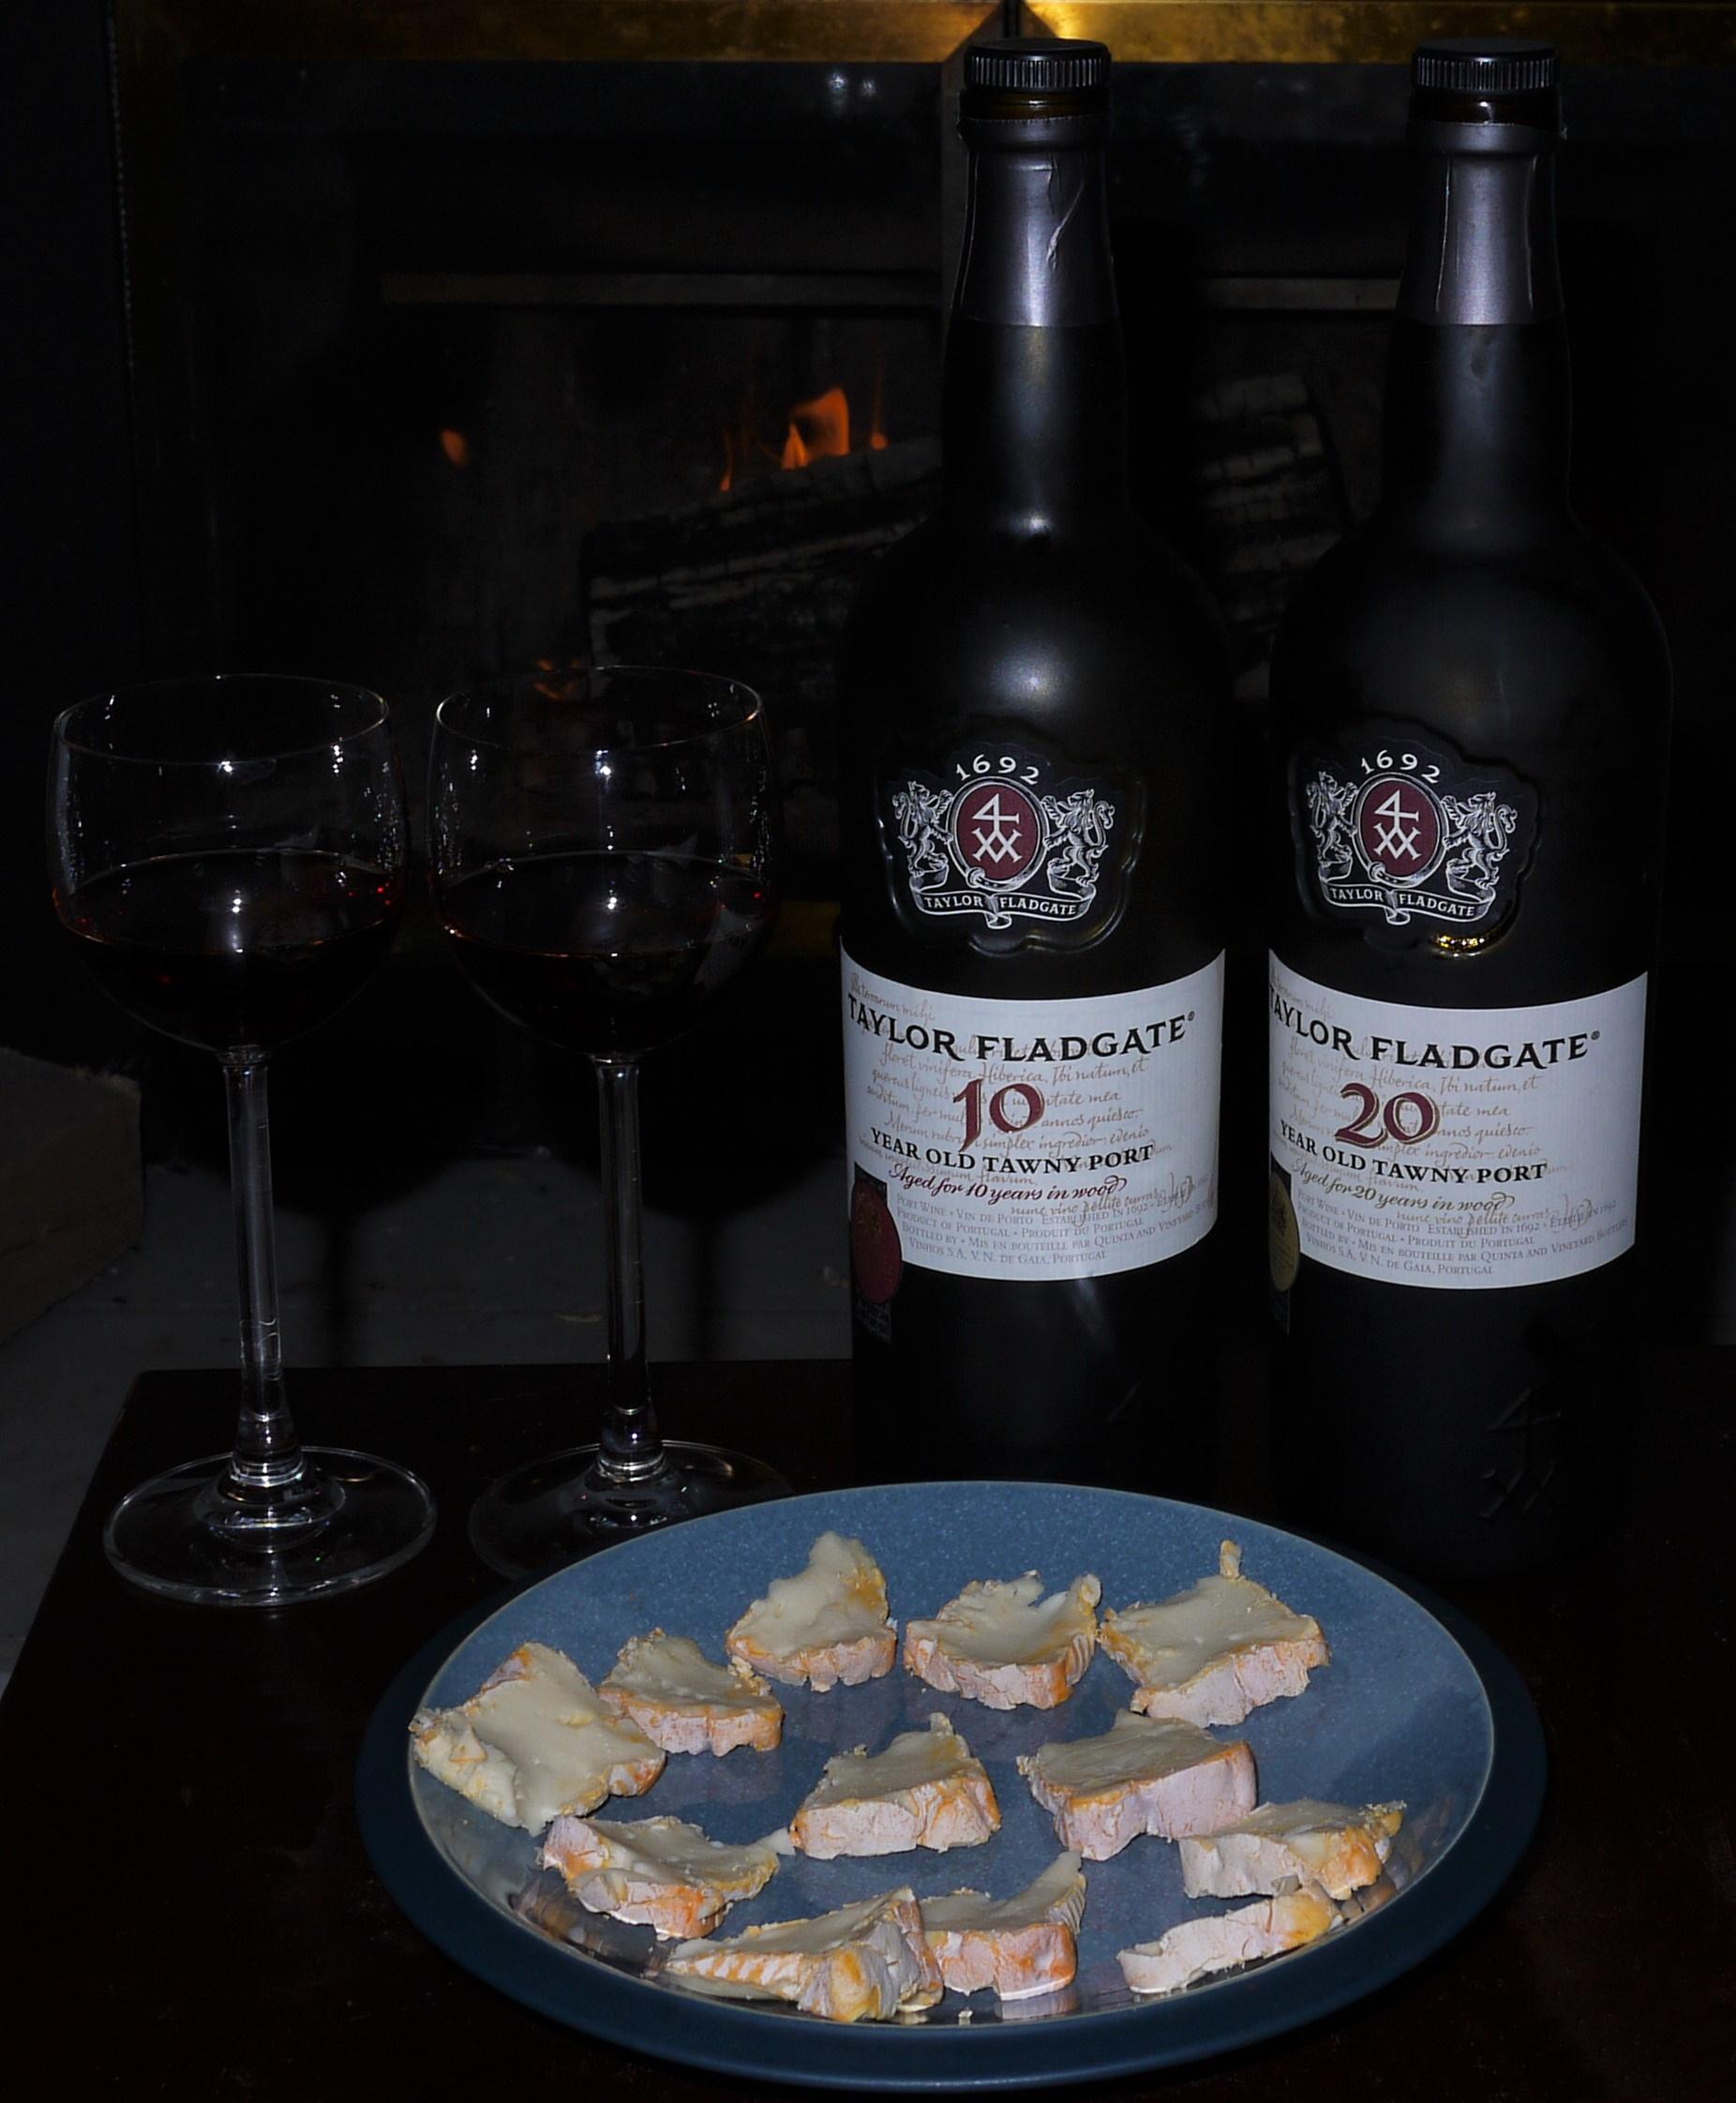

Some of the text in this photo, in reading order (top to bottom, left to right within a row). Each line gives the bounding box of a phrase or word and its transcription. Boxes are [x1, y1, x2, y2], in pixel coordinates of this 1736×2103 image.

[956, 754, 1040, 786] 1692
[1361, 750, 1441, 784] 1692
[923, 895, 1078, 916] TAYLOR FLADGATE
[1329, 887, 1476, 918] TAYLOR FLADGATE
[848, 993, 965, 1061] TAYLOR
[953, 1078, 1046, 1153] 10
[1335, 1083, 1441, 1149] 20
[871, 1127, 921, 1161] YEAR
[926, 1149, 975, 1171] OLD
[982, 1156, 1081, 1175] TAWNY
[1088, 1145, 1154, 1170] PORT
[1280, 1119, 1318, 1155] YEAR
[1323, 1145, 1366, 1171] OLD
[1372, 1159, 1470, 1184] TAWNY
[1477, 1164, 1548, 1184] PORT
[890, 1164, 1128, 1206] Aged for 10 years in wood
[1293, 1161, 1329, 1185] Aged
[1325, 1177, 1353, 1194] for
[1353, 1185, 1377, 1201] 20
[1374, 1194, 1429, 1209] years
[1431, 1195, 1454, 1210] in
